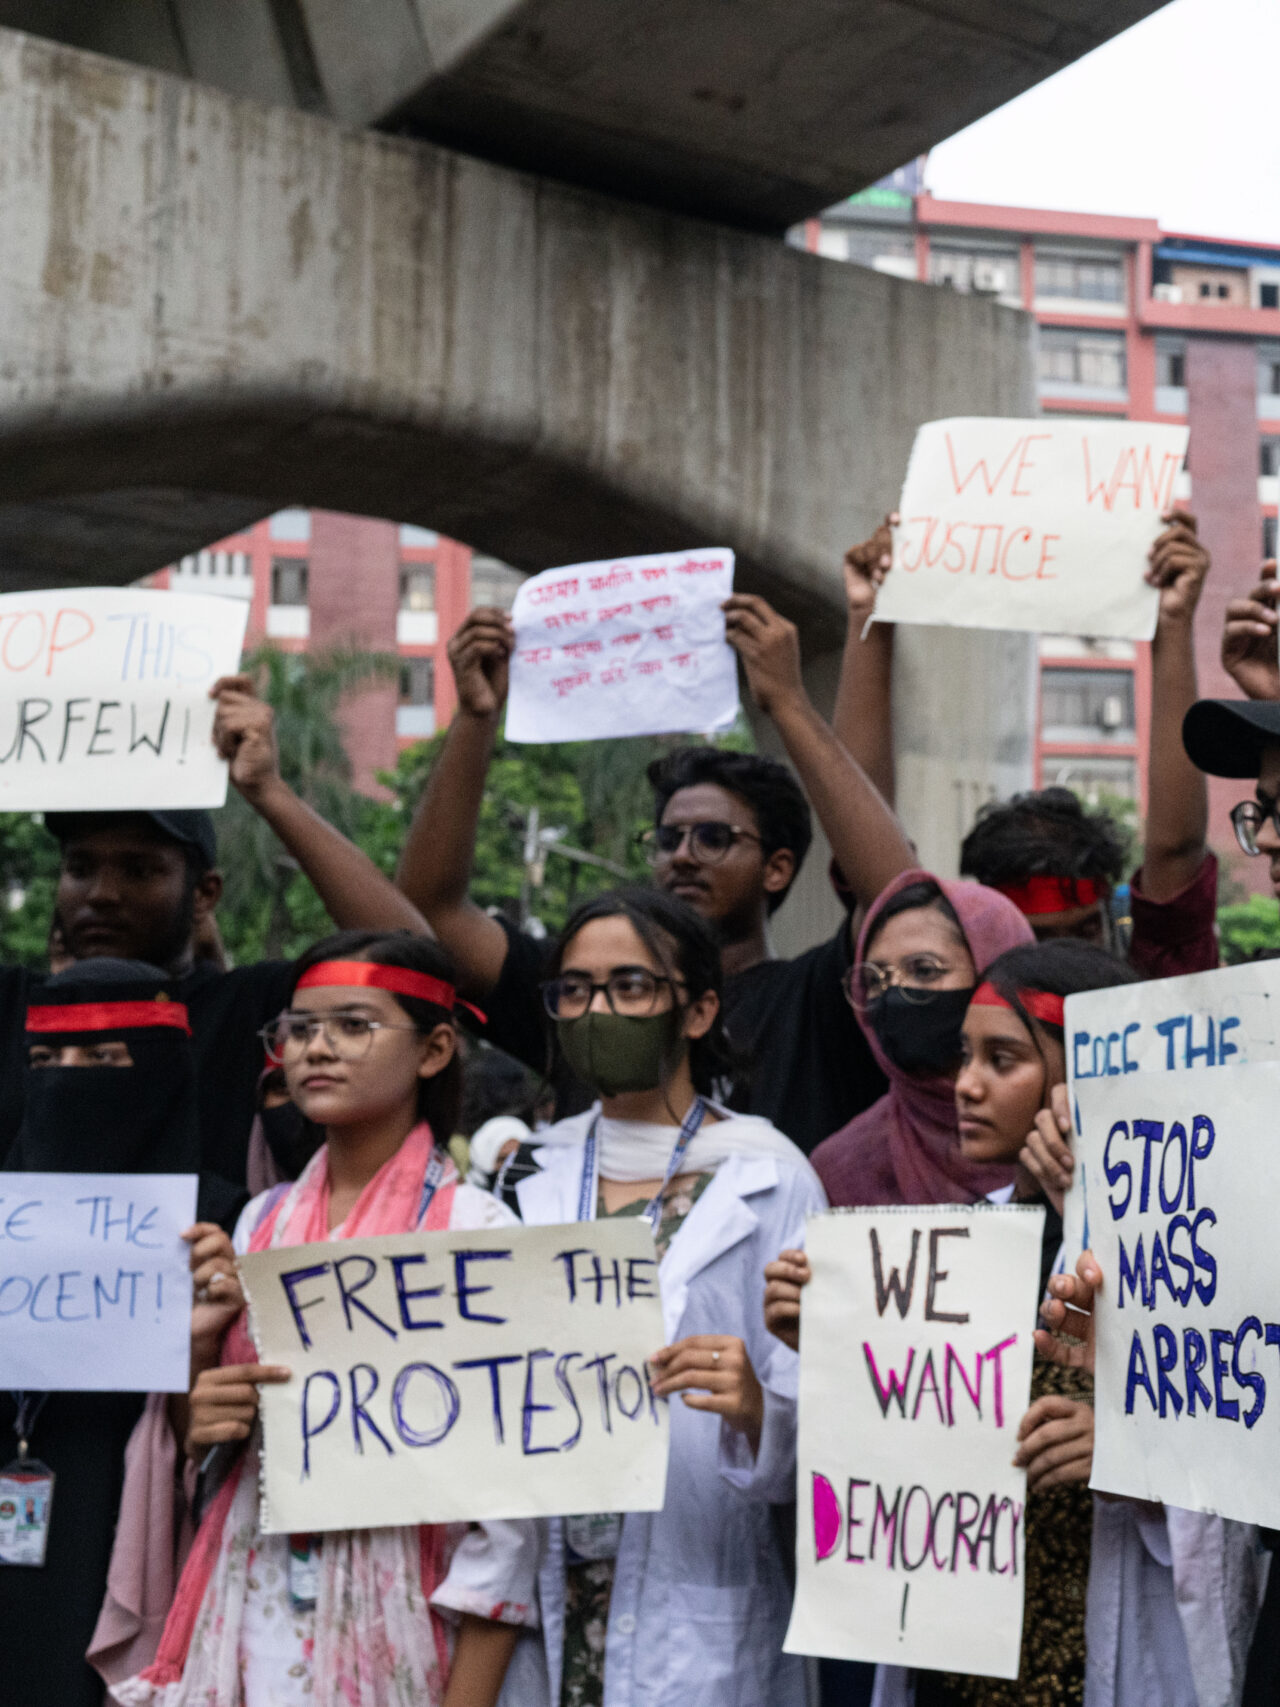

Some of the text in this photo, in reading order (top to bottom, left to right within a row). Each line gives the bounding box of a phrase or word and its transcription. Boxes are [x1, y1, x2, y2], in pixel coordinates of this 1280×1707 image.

[945, 432, 1184, 512] WE WANT
[901, 516, 1061, 581] JUSTICE
[106, 612, 214, 684] THIS
[1103, 1114, 1216, 1221] STOP
[76, 1196, 164, 1249] THE
[1117, 1207, 1218, 1311] MASS
[278, 1248, 657, 1352] FREE THE
[869, 1227, 971, 1324] WE
[862, 1333, 1018, 1428] WANT
[811, 1470, 1022, 1578] DEMOCRACY
